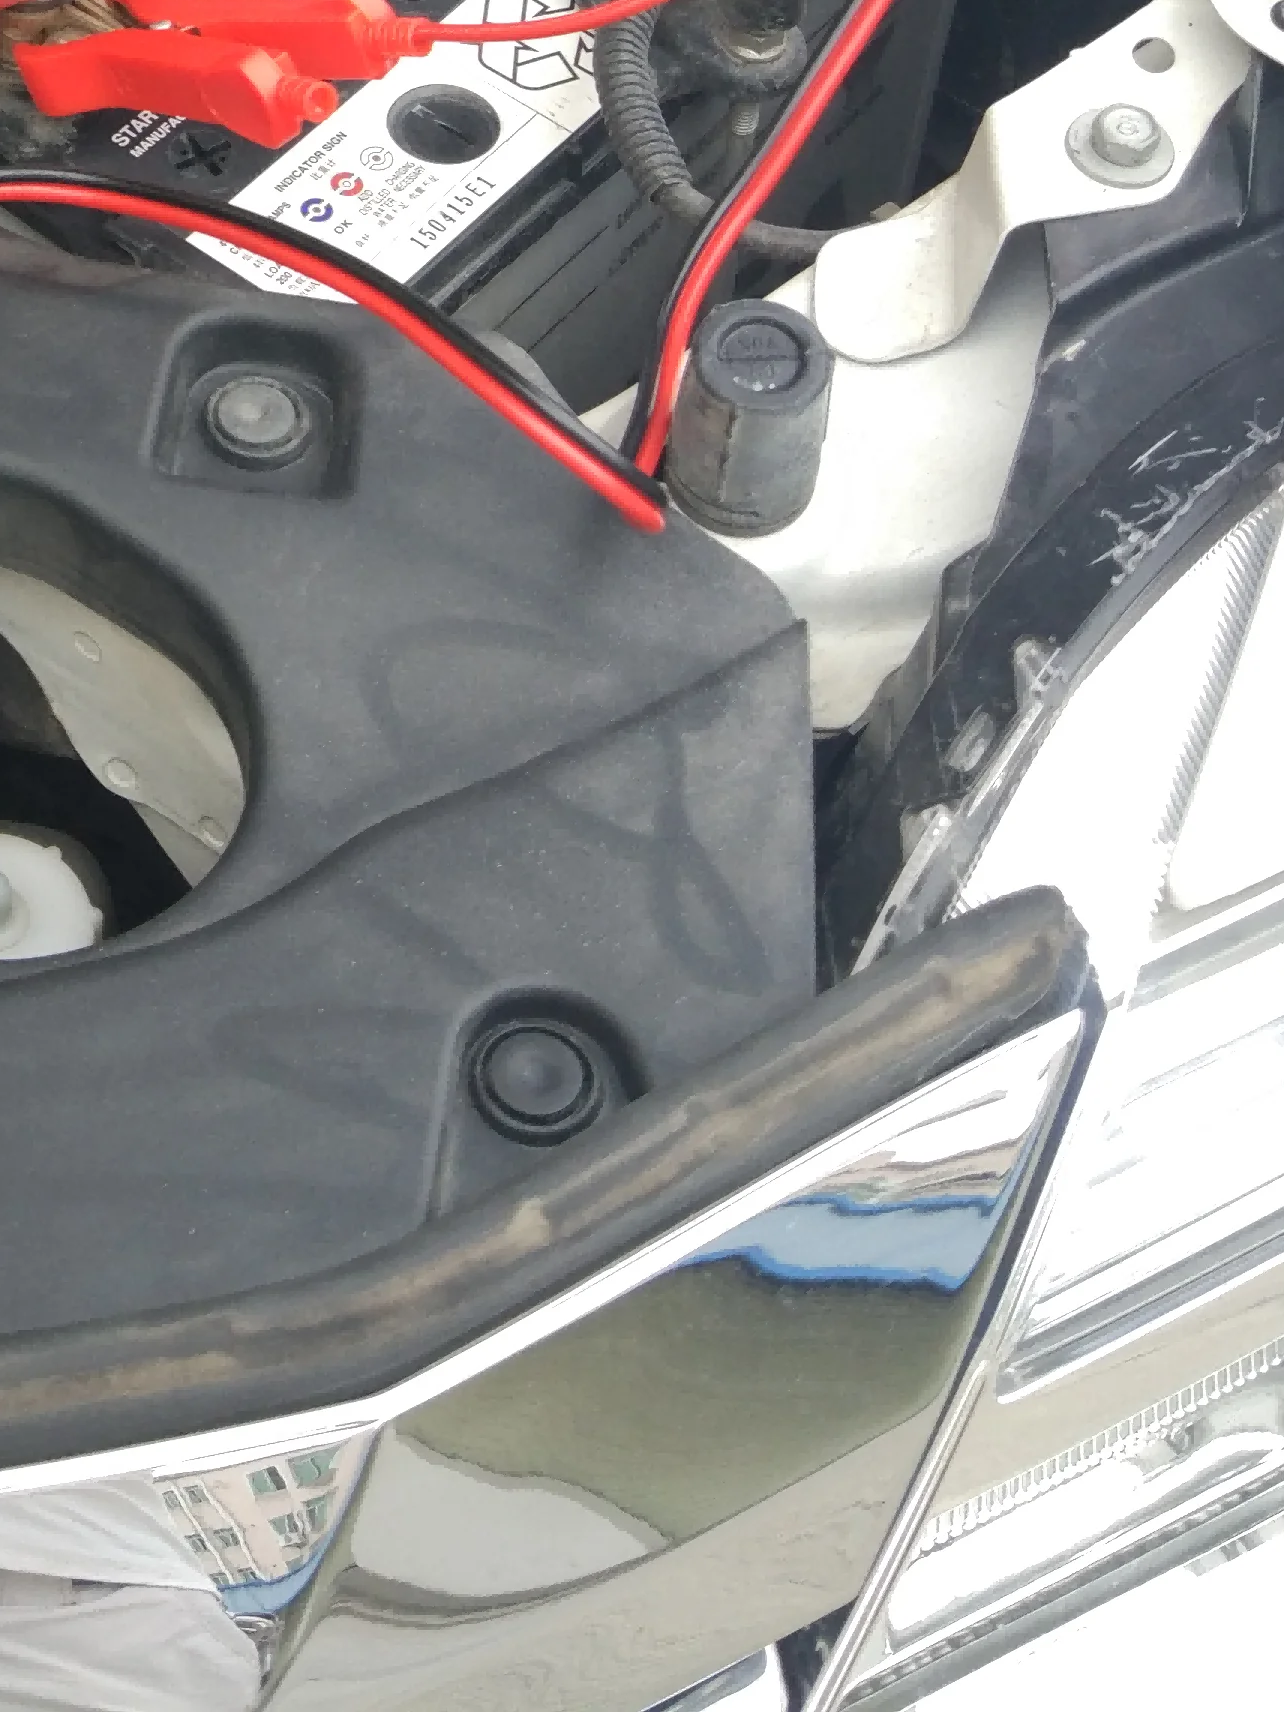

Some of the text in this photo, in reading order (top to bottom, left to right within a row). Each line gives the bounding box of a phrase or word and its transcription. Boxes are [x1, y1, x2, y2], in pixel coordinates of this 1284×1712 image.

[274, 131, 348, 193] INDICATOR SIGN
[333, 219, 353, 235] OK
[409, 176, 497, 249] 150415E1
